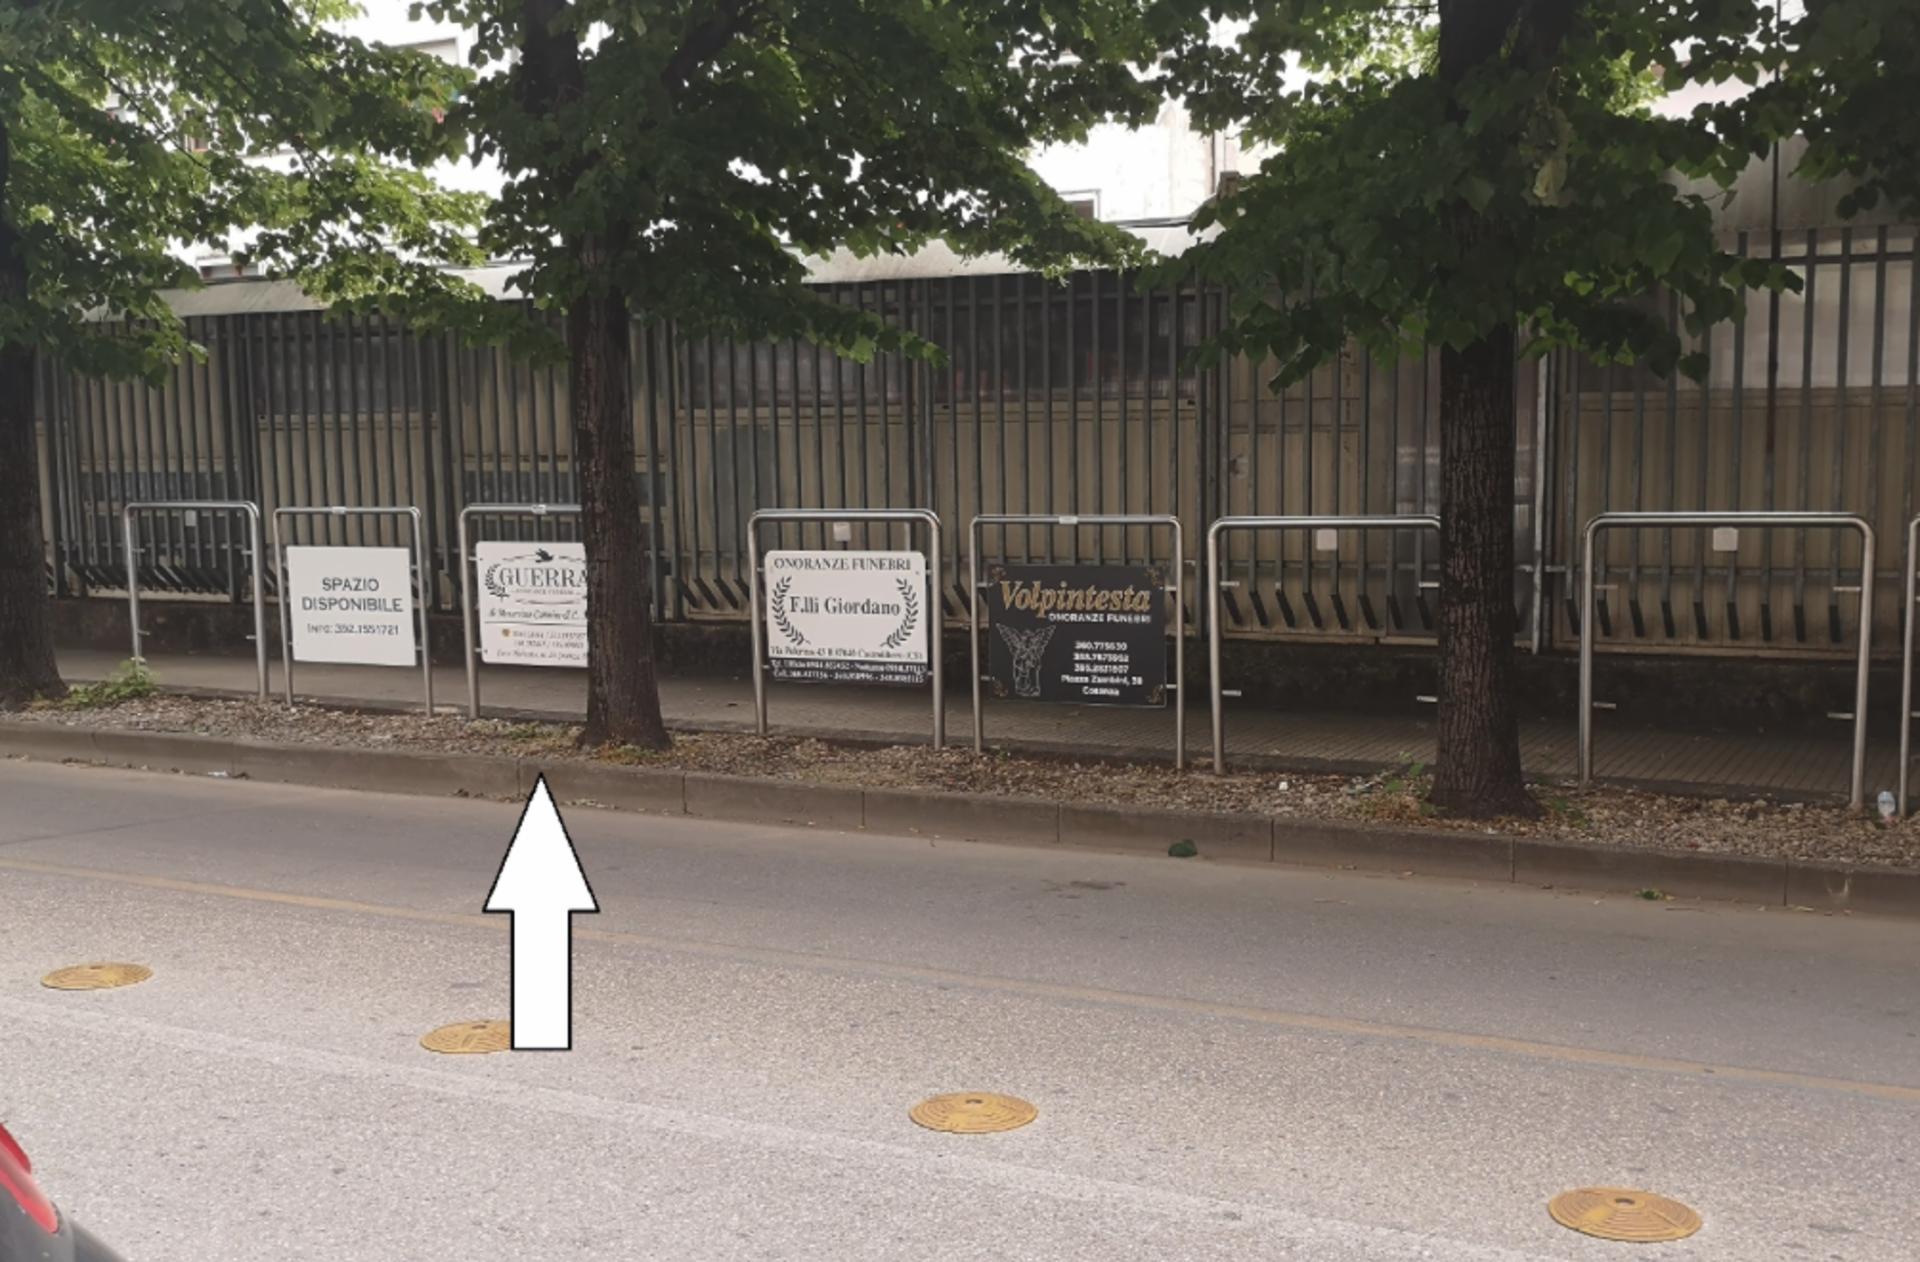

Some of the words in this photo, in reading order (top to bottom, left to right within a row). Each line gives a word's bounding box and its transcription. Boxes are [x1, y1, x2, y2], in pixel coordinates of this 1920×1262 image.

[773, 557, 850, 571] ONORANZE
[852, 557, 912, 571] FUNEBRI
[322, 577, 380, 592] SPAZIO
[301, 596, 404, 613] DISPONIBILE
[790, 596, 820, 614] F.lli
[824, 596, 901, 616] Giordano
[1000, 580, 1151, 619] Volpintesta
[1048, 612, 1105, 623] ONORANZE
[1106, 612, 1152, 624] FUNEBRI
